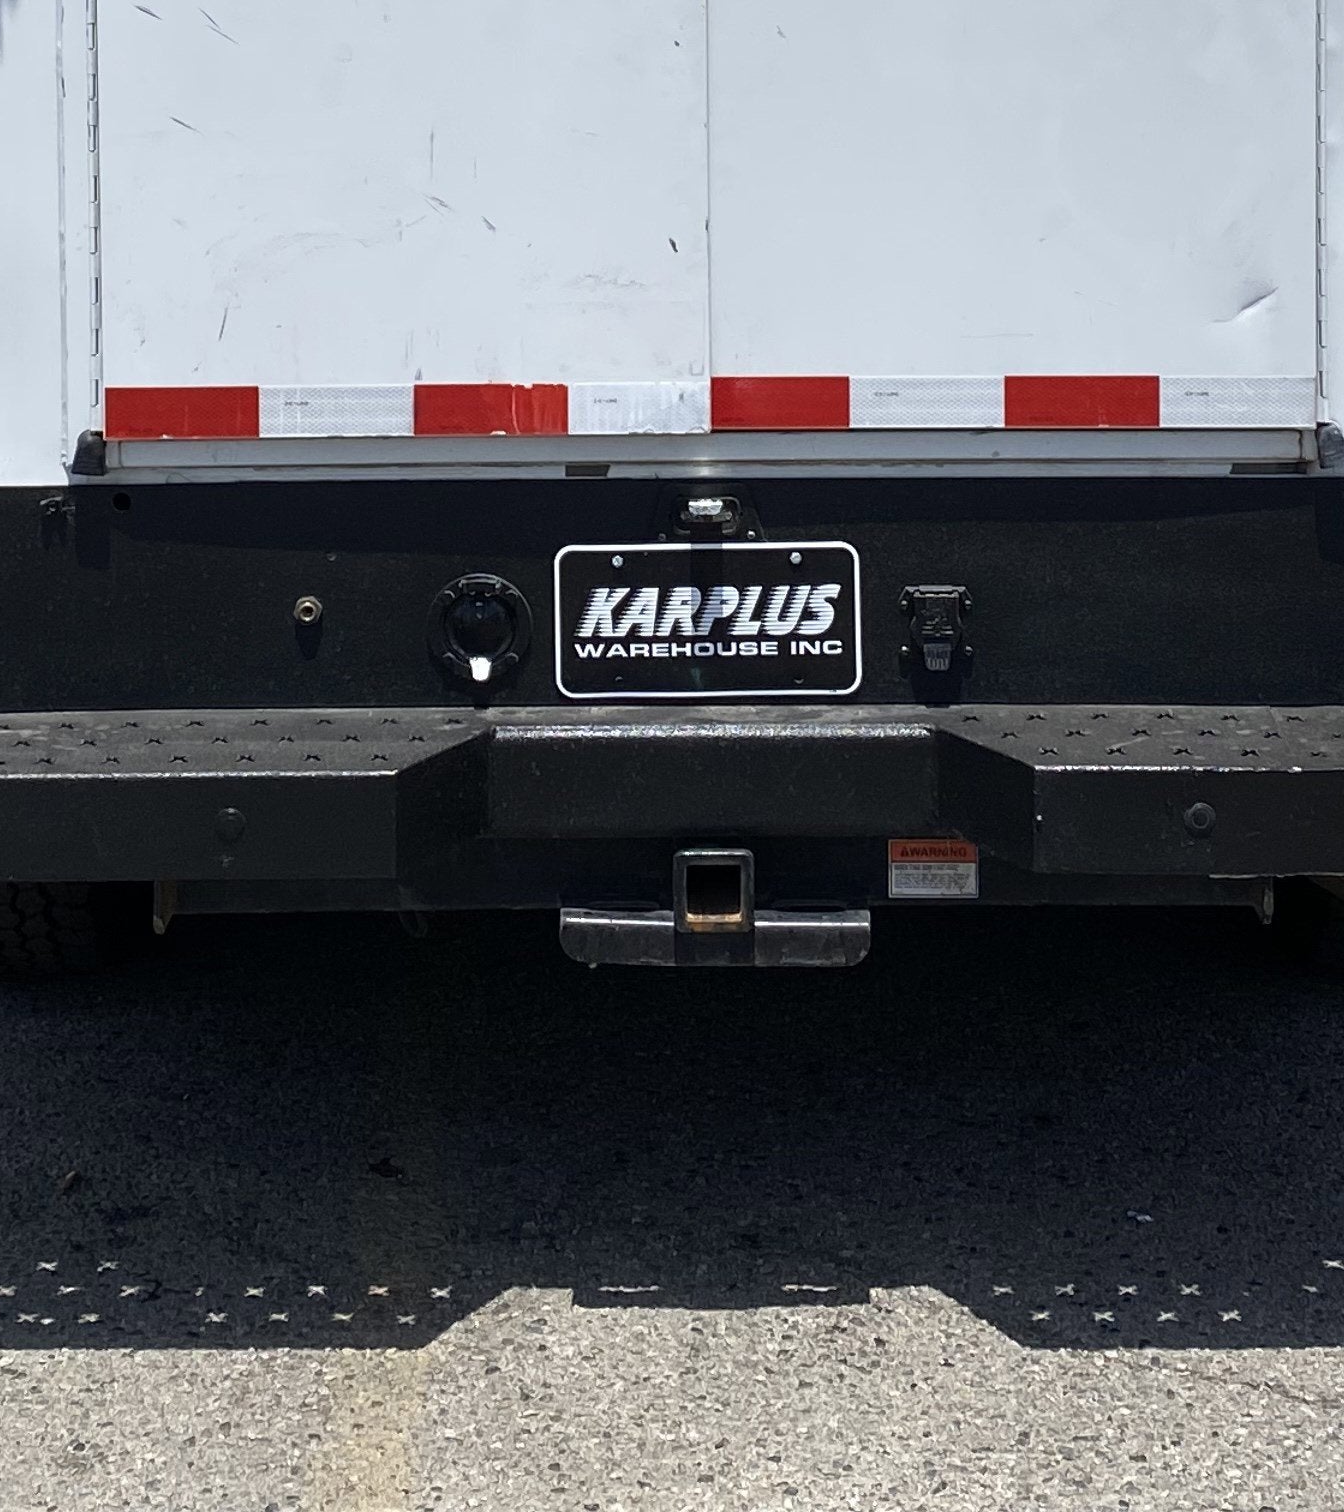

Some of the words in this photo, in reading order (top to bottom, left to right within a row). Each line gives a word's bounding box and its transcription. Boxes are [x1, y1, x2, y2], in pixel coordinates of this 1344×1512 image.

[573, 583, 843, 637] KARPLUS
[574, 640, 779, 658] WAREHOUSE
[790, 639, 844, 656] INC
